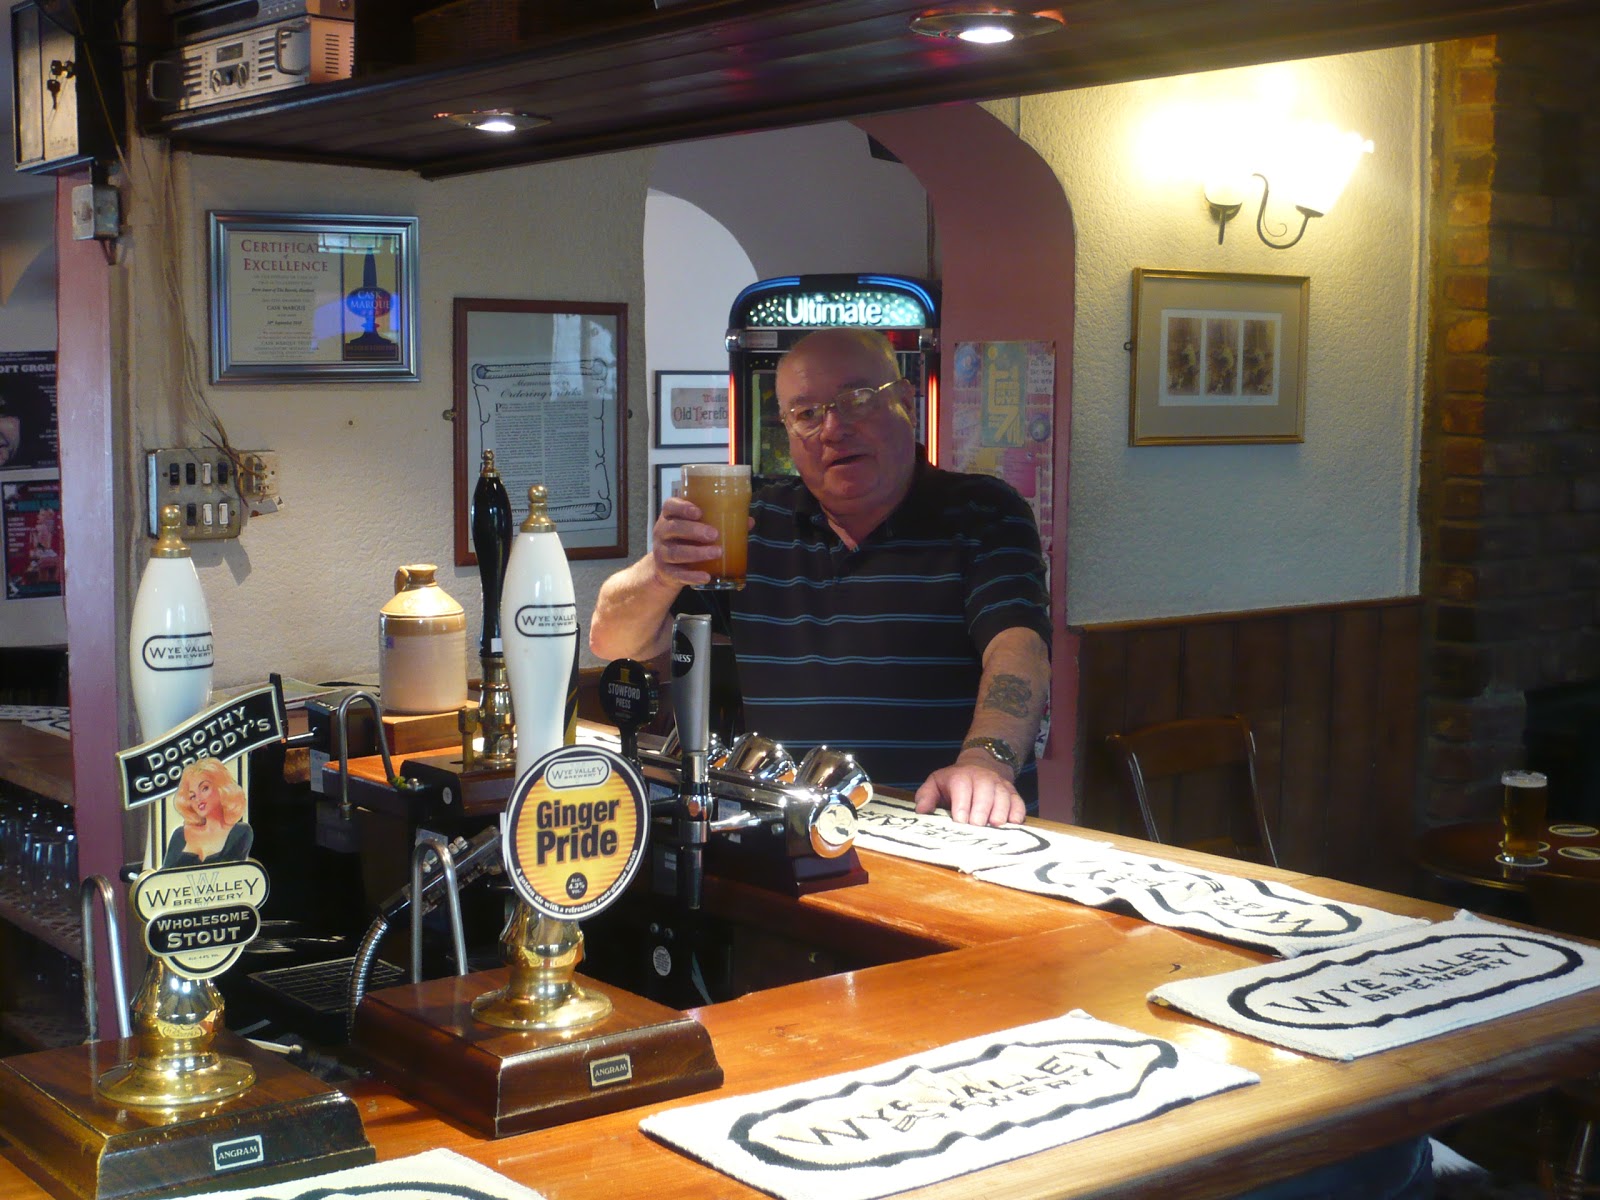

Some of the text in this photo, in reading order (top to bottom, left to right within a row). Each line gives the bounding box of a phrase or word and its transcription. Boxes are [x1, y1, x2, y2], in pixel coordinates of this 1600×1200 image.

[241, 239, 321, 253] CERTIFICAT
[244, 258, 328, 272] EXCELLENCE
[785, 297, 883, 325] Ultimate
[500, 389, 547, 400] Ordering
[673, 407, 692, 422] Old
[521, 615, 550, 626] WYE
[150, 647, 182, 659] WYE
[608, 683, 641, 700] STOWFORD
[615, 698, 631, 709] PRESS
[147, 706, 246, 771] DOROTHY
[551, 766, 604, 780] WYE VALLEY
[537, 799, 620, 830] Ginger
[537, 825, 618, 865] Pride
[146, 877, 259, 908] WYE VALLEY
[173, 892, 244, 907] BREWERY
[535, 895, 544, 905] ale
[544, 901, 559, 912] with
[565, 901, 598, 913] refreshing
[157, 910, 250, 931] WHOLESOME
[167, 926, 241, 949] STOUT
[1264, 978, 1388, 1013] WYE
[595, 1063, 628, 1077] ANGRAM
[218, 1145, 258, 1160] ANGRAM
